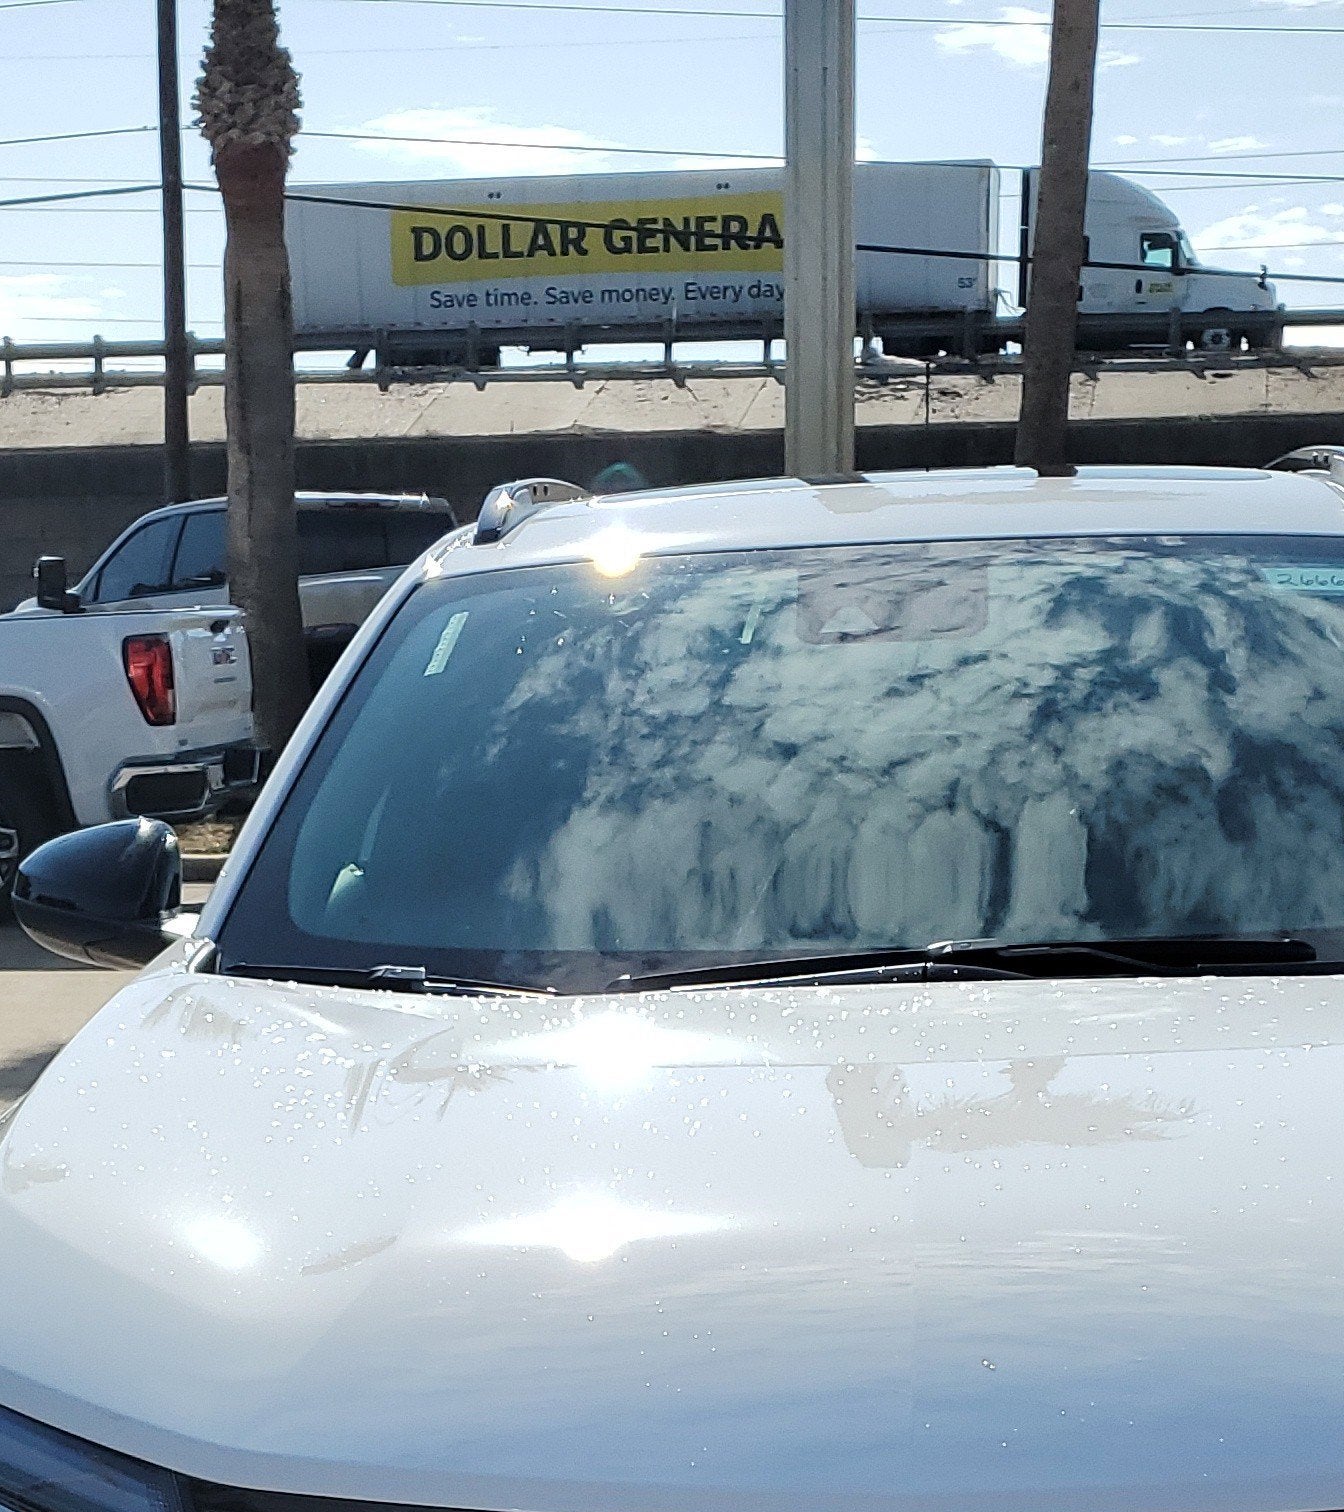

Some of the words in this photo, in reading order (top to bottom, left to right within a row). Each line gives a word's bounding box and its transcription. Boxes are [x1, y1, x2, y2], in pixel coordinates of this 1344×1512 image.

[411, 221, 589, 262] DOLLAR
[603, 213, 784, 255] GENERA
[429, 290, 478, 309] Save
[484, 287, 538, 307] time.
[545, 286, 594, 305] Save
[684, 281, 743, 303] Every
